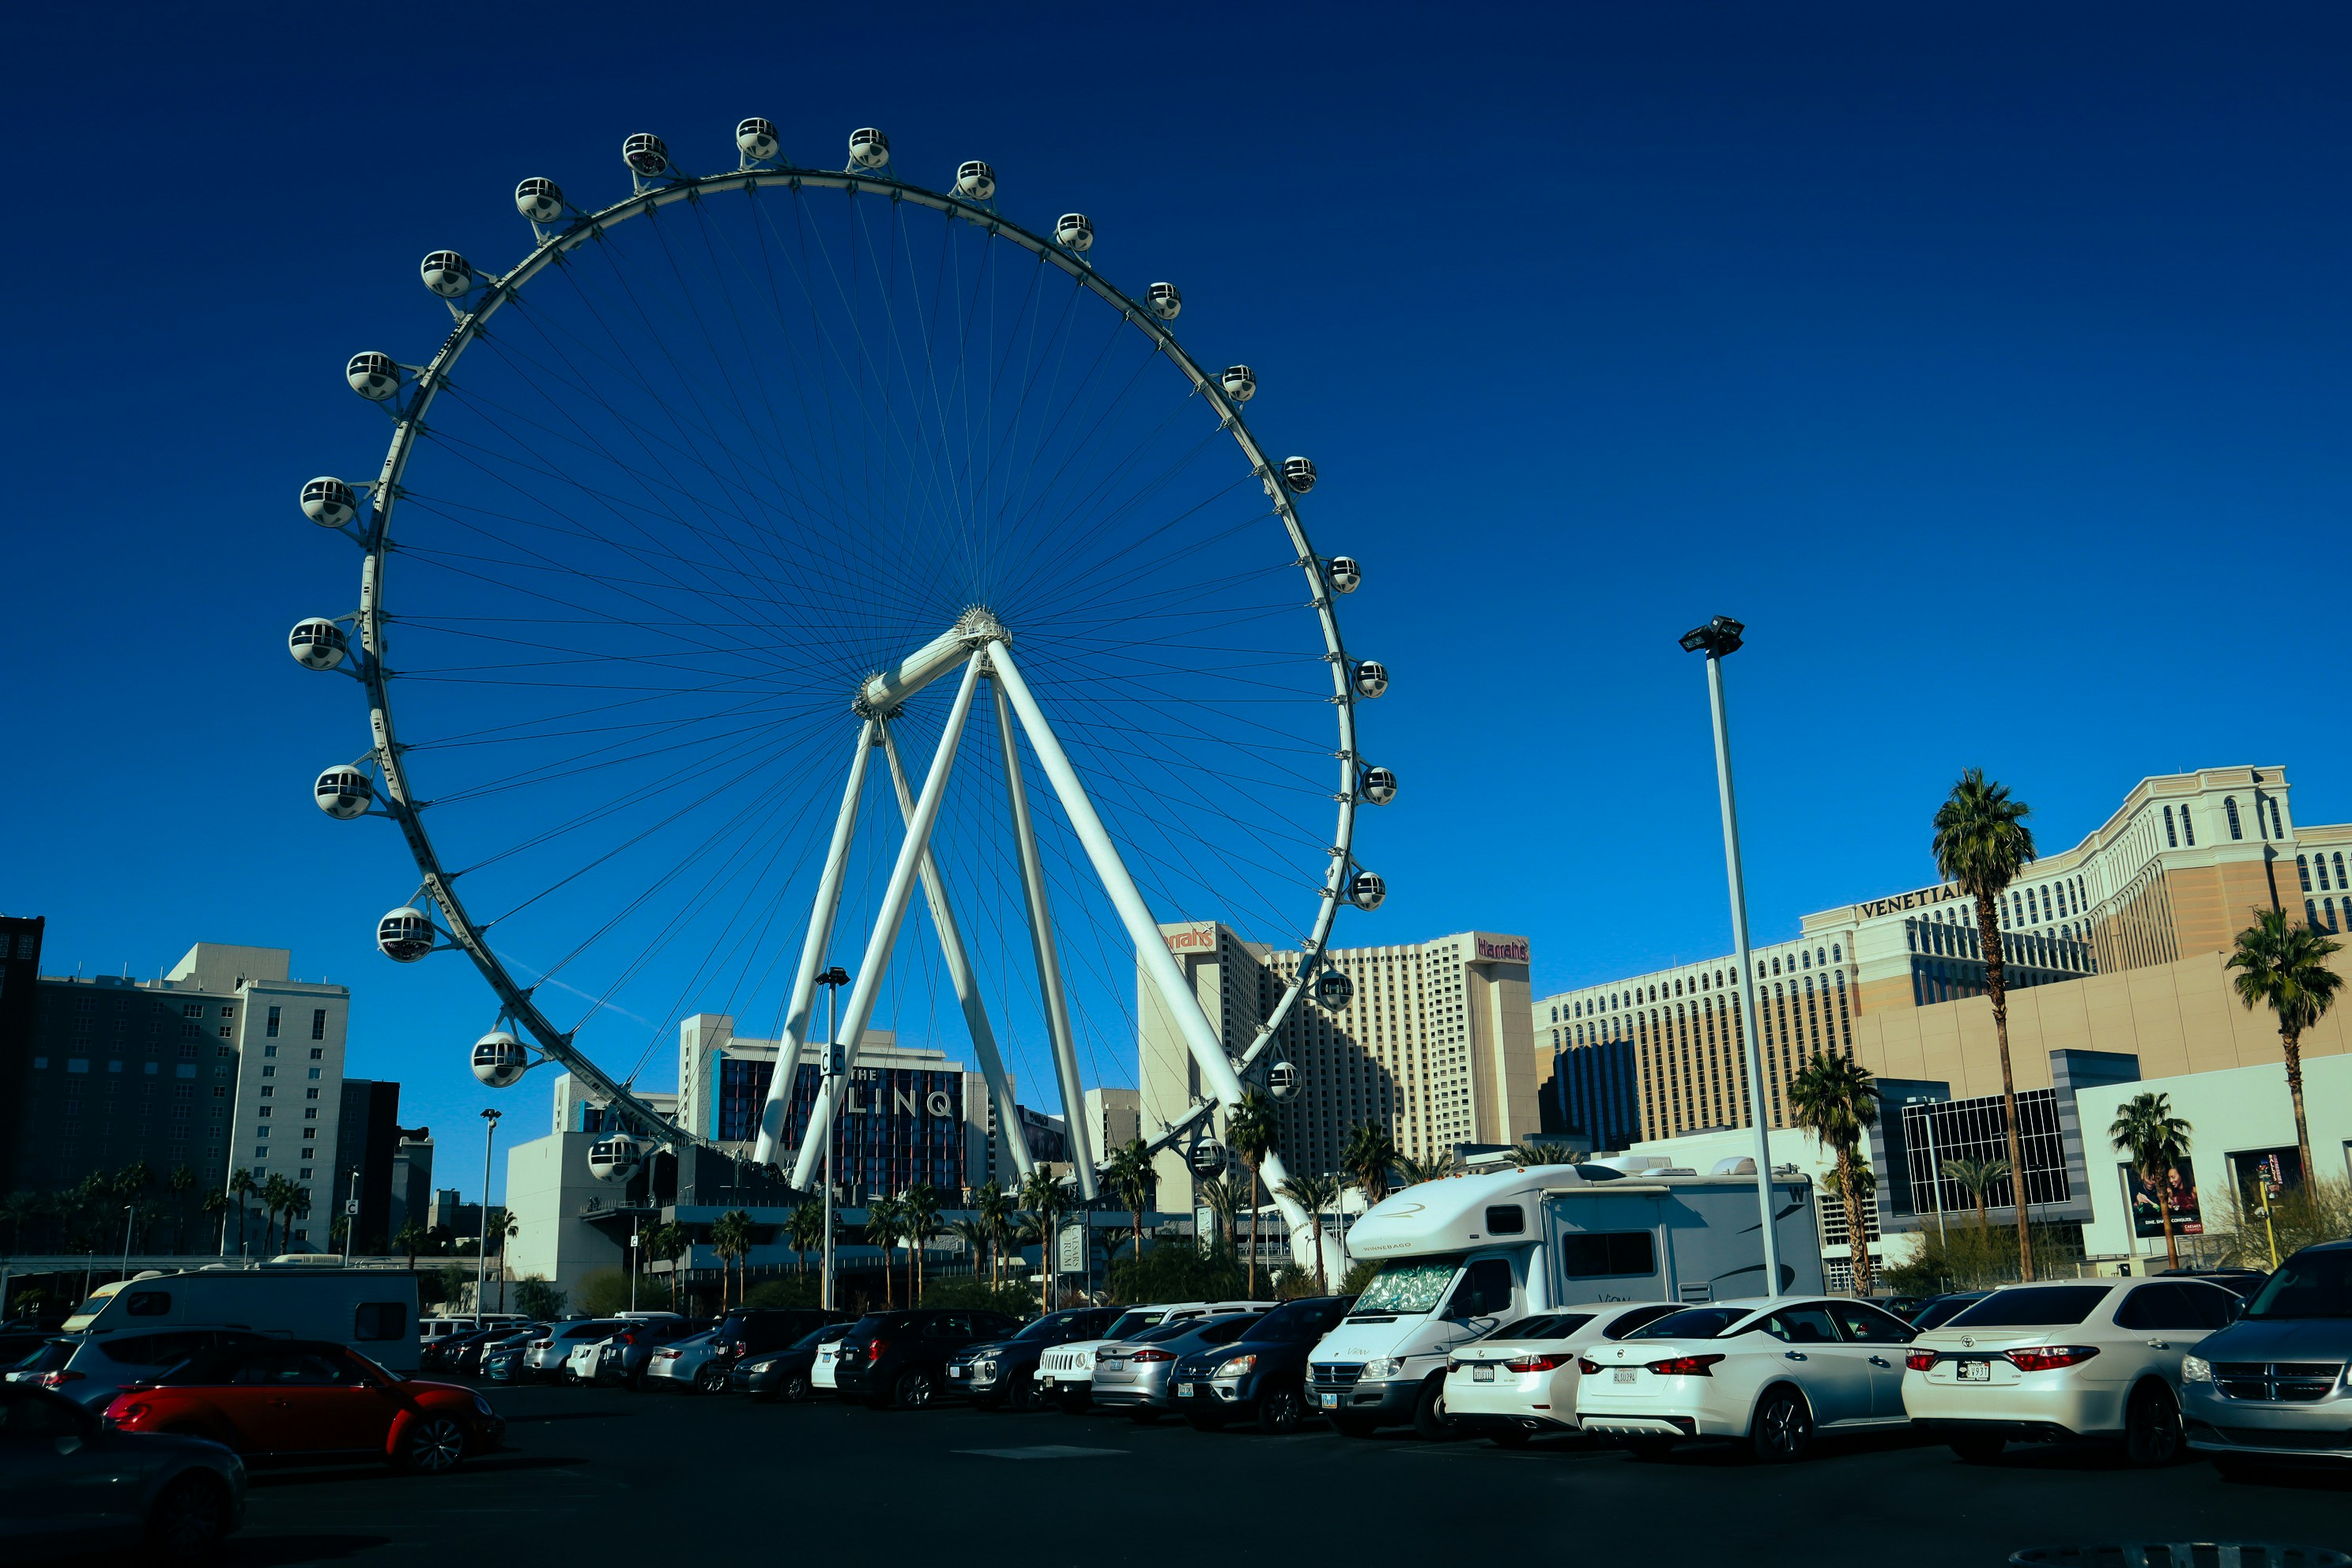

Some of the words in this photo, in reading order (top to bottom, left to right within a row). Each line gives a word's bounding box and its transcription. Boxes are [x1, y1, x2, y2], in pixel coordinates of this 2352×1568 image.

[822, 1053, 828, 1072] C
[833, 1053, 842, 1072] C
[850, 1069, 876, 1080] THE
[848, 1087, 952, 1118] LINQ
[348, 1204, 356, 1213] C
[1363, 1242, 1412, 1251] WINNEBAGO
